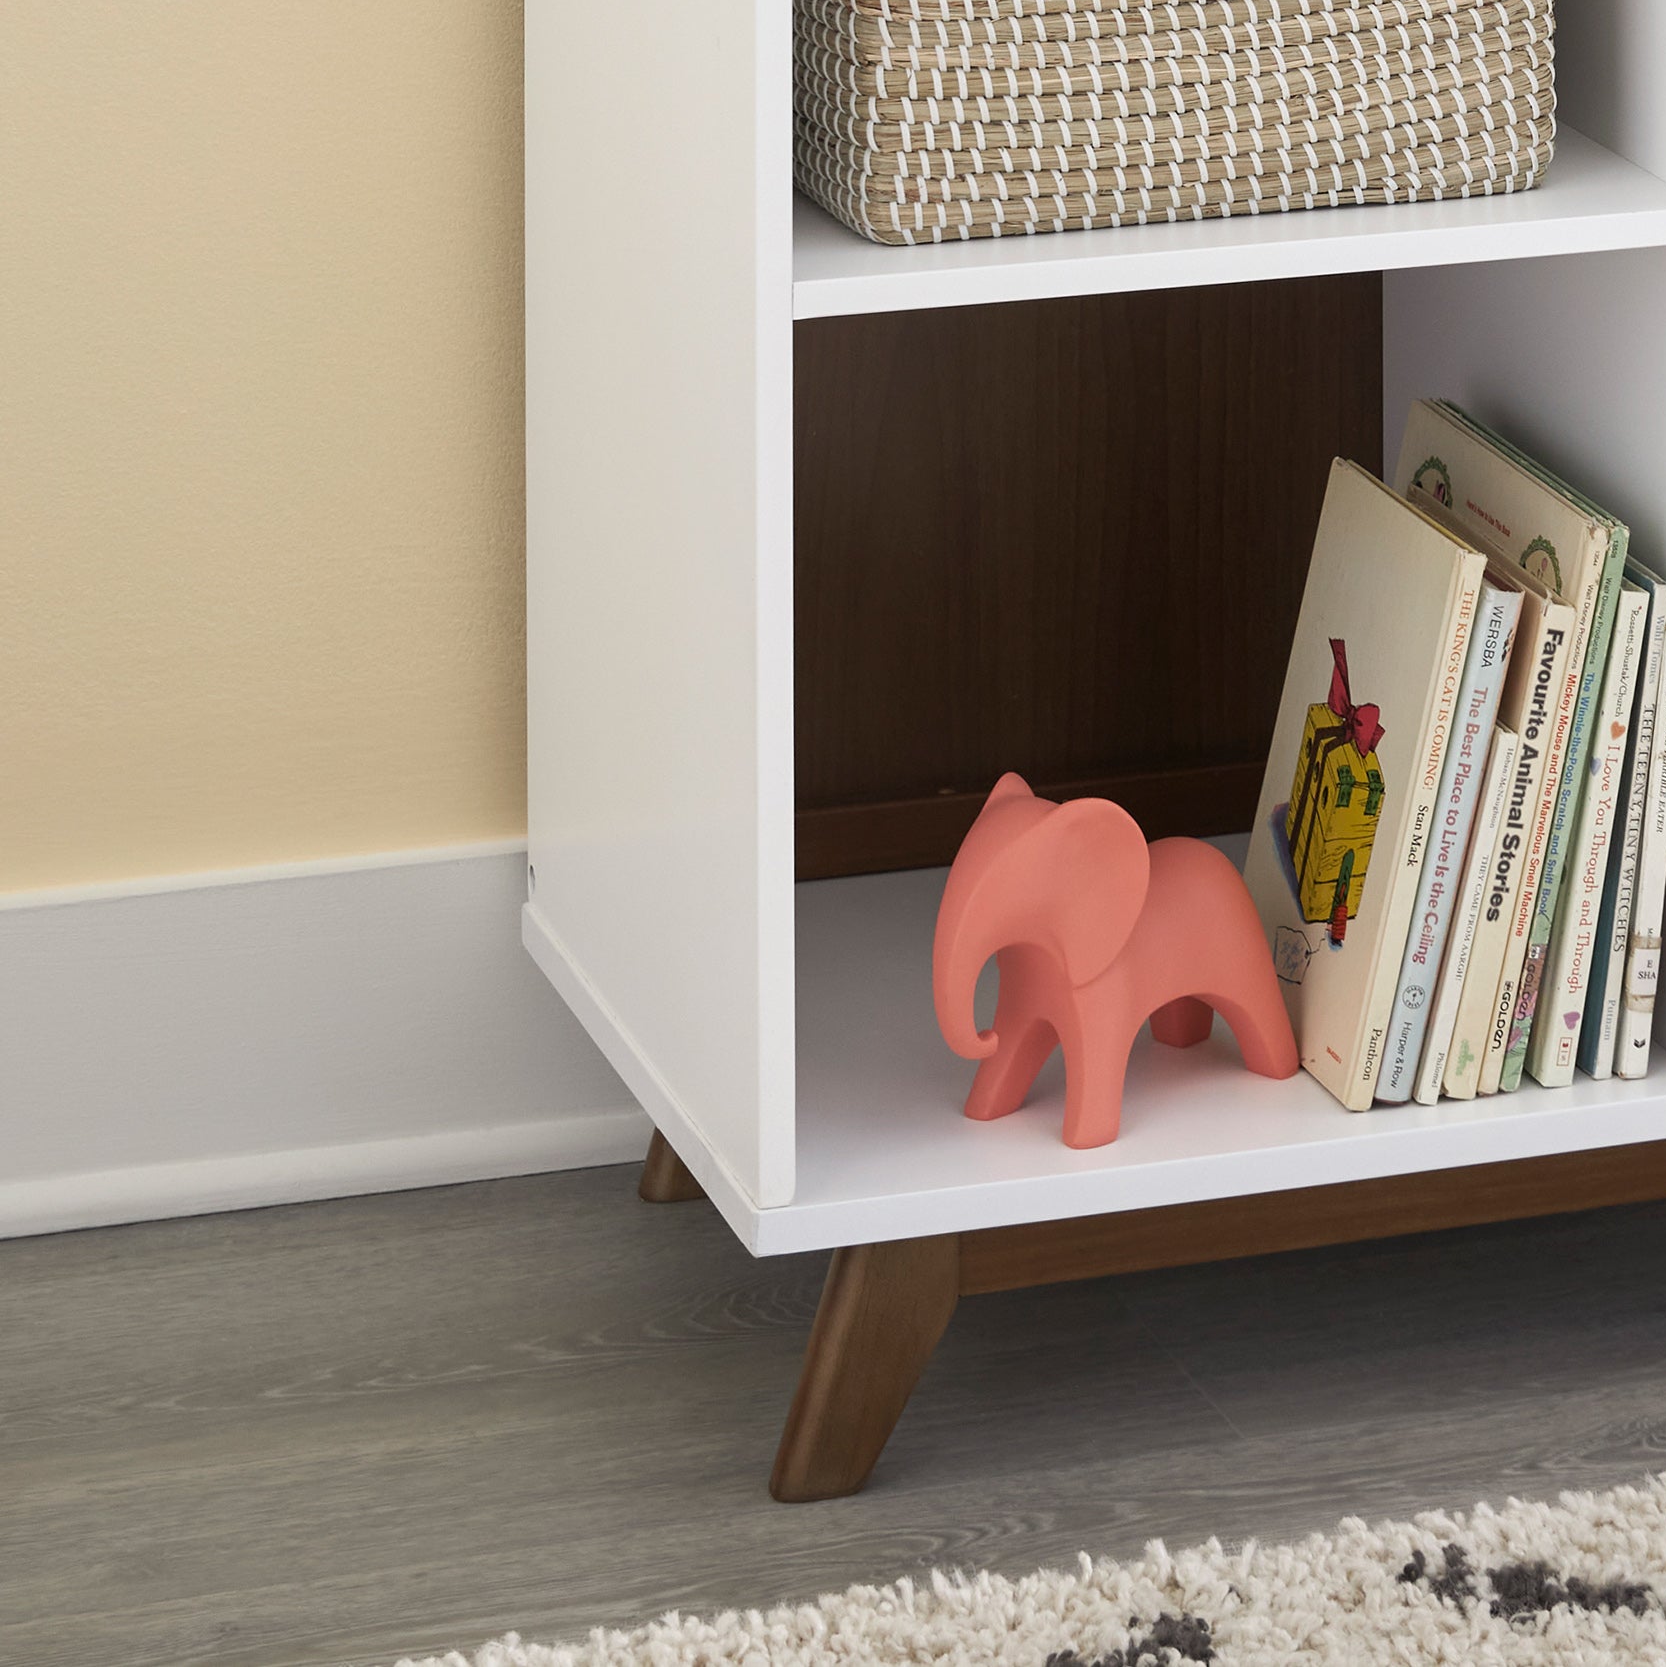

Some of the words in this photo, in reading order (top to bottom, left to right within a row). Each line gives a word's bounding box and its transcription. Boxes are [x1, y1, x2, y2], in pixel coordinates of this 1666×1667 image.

[1584, 583, 1594, 603] Walt
[1603, 577, 1613, 595] Walt
[1457, 589, 1475, 620] THE
[1578, 602, 1591, 627] Disney
[1598, 594, 1610, 620] Disney
[1481, 605, 1505, 668] WERSBA
[1589, 620, 1604, 666] Productions
[1653, 614, 1666, 642] Wahl
[1448, 622, 1468, 673] KING'S
[1571, 627, 1586, 670] Productions
[1615, 609, 1642, 718] Rossetti-Shustak/Church
[1583, 672, 1596, 693] The
[1648, 649, 1662, 686] Tomes
[1441, 675, 1457, 707] CAT
[1521, 627, 1566, 742] Favourite
[1559, 673, 1578, 713] Mickey
[1436, 709, 1450, 728] IS
[1468, 686, 1489, 718] The
[1459, 722, 1480, 758] Best
[1554, 714, 1571, 752] Mouse
[1564, 694, 1591, 785] Winnie-the-Pooh
[1640, 703, 1656, 744] THE
[1422, 727, 1447, 792] COMING!
[1549, 753, 1559, 775] and
[1607, 744, 1621, 752] I
[1450, 762, 1472, 805] Place
[1506, 742, 1541, 831] Animal
[1544, 775, 1558, 798] The
[1601, 753, 1619, 792] Love
[1629, 745, 1650, 815] TEENY,
[1414, 804, 1430, 831] Stan
[1445, 808, 1460, 826] to
[1557, 787, 1572, 832] Scratch
[1595, 796, 1612, 826] You
[1655, 799, 1666, 834] EATER
[1532, 799, 1552, 855] Marvelous
[1552, 832, 1562, 855] and
[1625, 816, 1640, 866] TINY
[1406, 833, 1425, 867] Mack
[1435, 830, 1458, 863] Live
[1582, 830, 1607, 895] Through
[1434, 863, 1450, 879] Is
[1475, 853, 1490, 883] THEY
[1485, 832, 1522, 924] Stories
[1527, 857, 1541, 889] Smell
[1544, 857, 1558, 887] Sniff
[1427, 881, 1446, 909] the
[1470, 884, 1484, 911] CAME
[1538, 887, 1552, 916] Book
[1613, 866, 1634, 953] WITCHES
[1463, 910, 1479, 941] FROM
[1516, 890, 1535, 938] Machine
[1578, 899, 1591, 927] and
[1412, 912, 1439, 966] Ceiling
[1455, 942, 1471, 983] AARGH!
[1568, 931, 1591, 996] Through
[1637, 971, 1657, 980] SHA
[1647, 959, 1653, 969] E
[1604, 999, 1617, 1041] Putnam
[1397, 1021, 1414, 1054] Harper
[1362, 1027, 1384, 1082] Pantheon
[1395, 1053, 1406, 1065] &
[1390, 1064, 1404, 1089] Row
